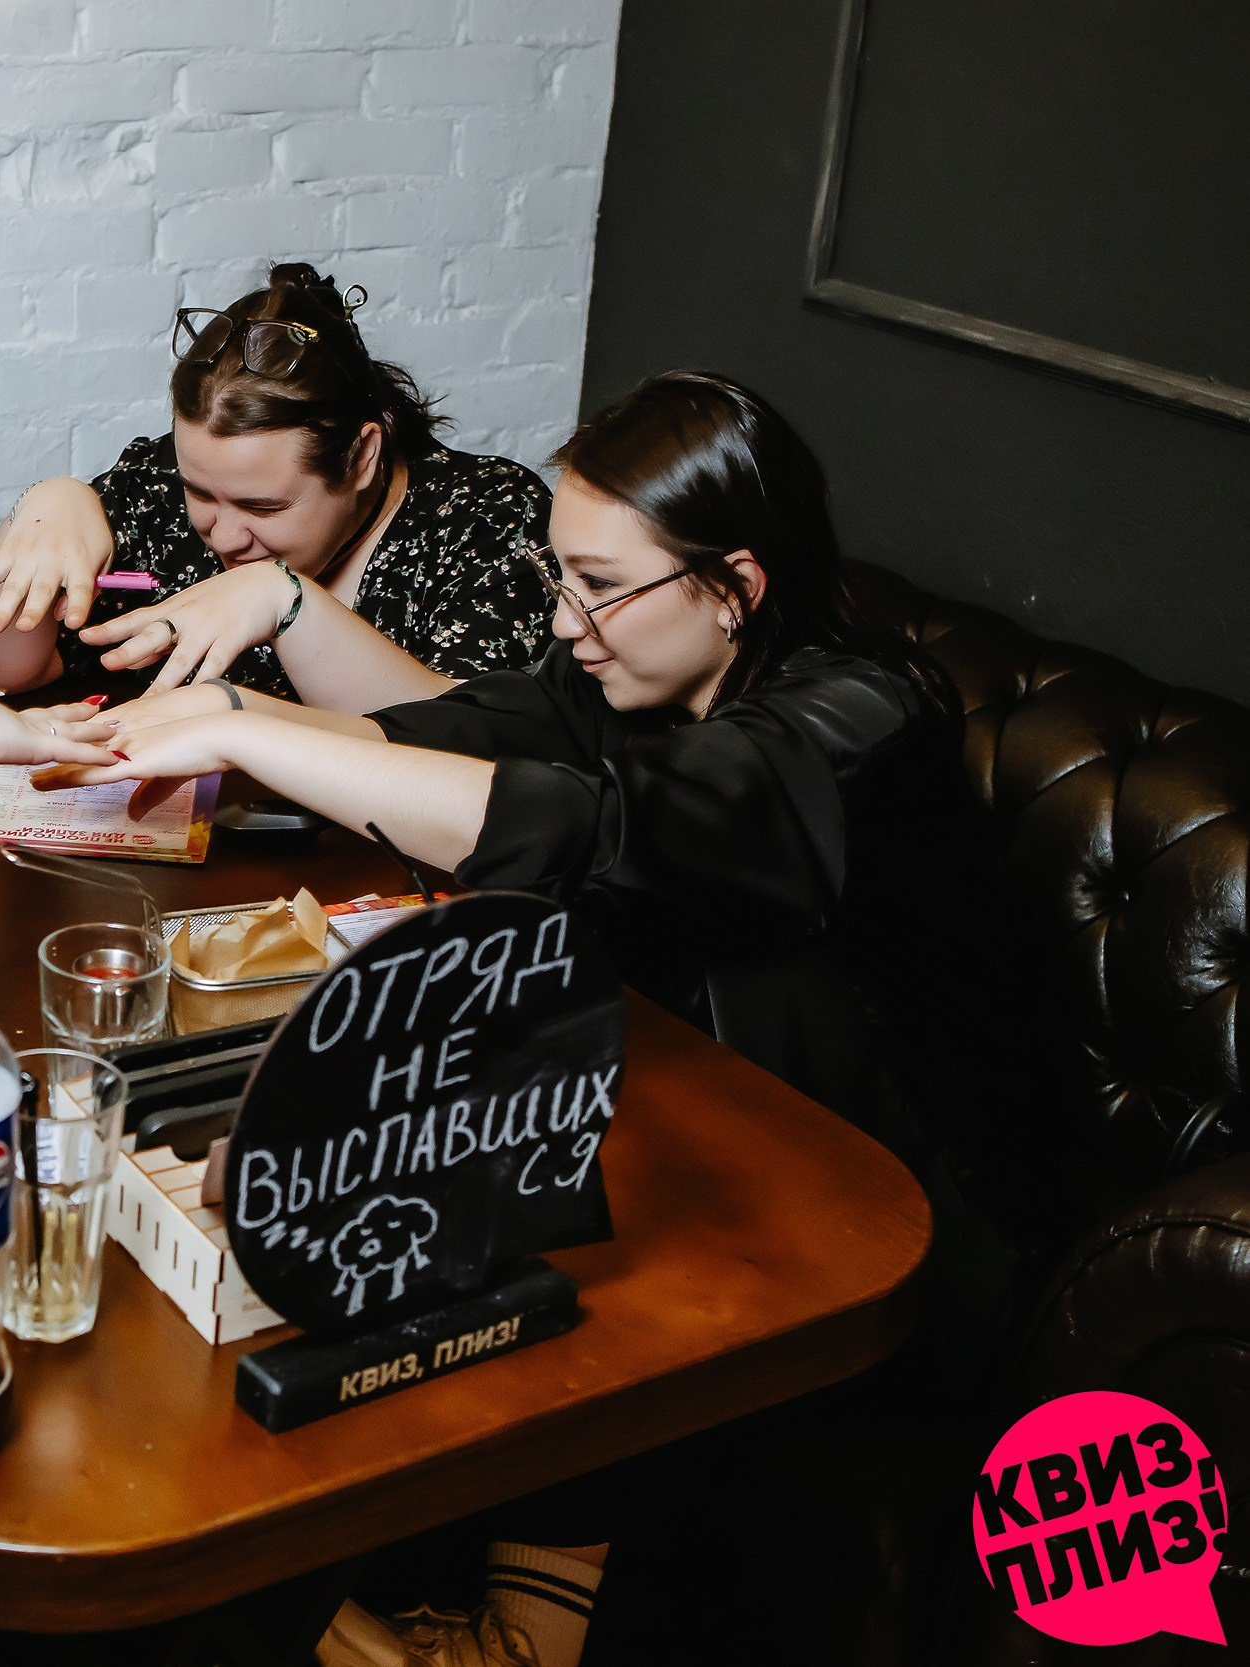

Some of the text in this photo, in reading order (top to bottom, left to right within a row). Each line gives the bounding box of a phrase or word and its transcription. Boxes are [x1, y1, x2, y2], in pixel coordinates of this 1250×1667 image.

[32, 832, 101, 843] ПРОСТО
[91, 831, 126, 840] ДЛЯ
[104, 836, 125, 844] НЕ
[308, 911, 574, 1053] ОТРЯД
[369, 1027, 477, 1110] НЕ
[236, 1064, 619, 1230] ВЫСПАВШИХ
[340, 1316, 521, 1401] КВИЗ, ПЛИЗ!
